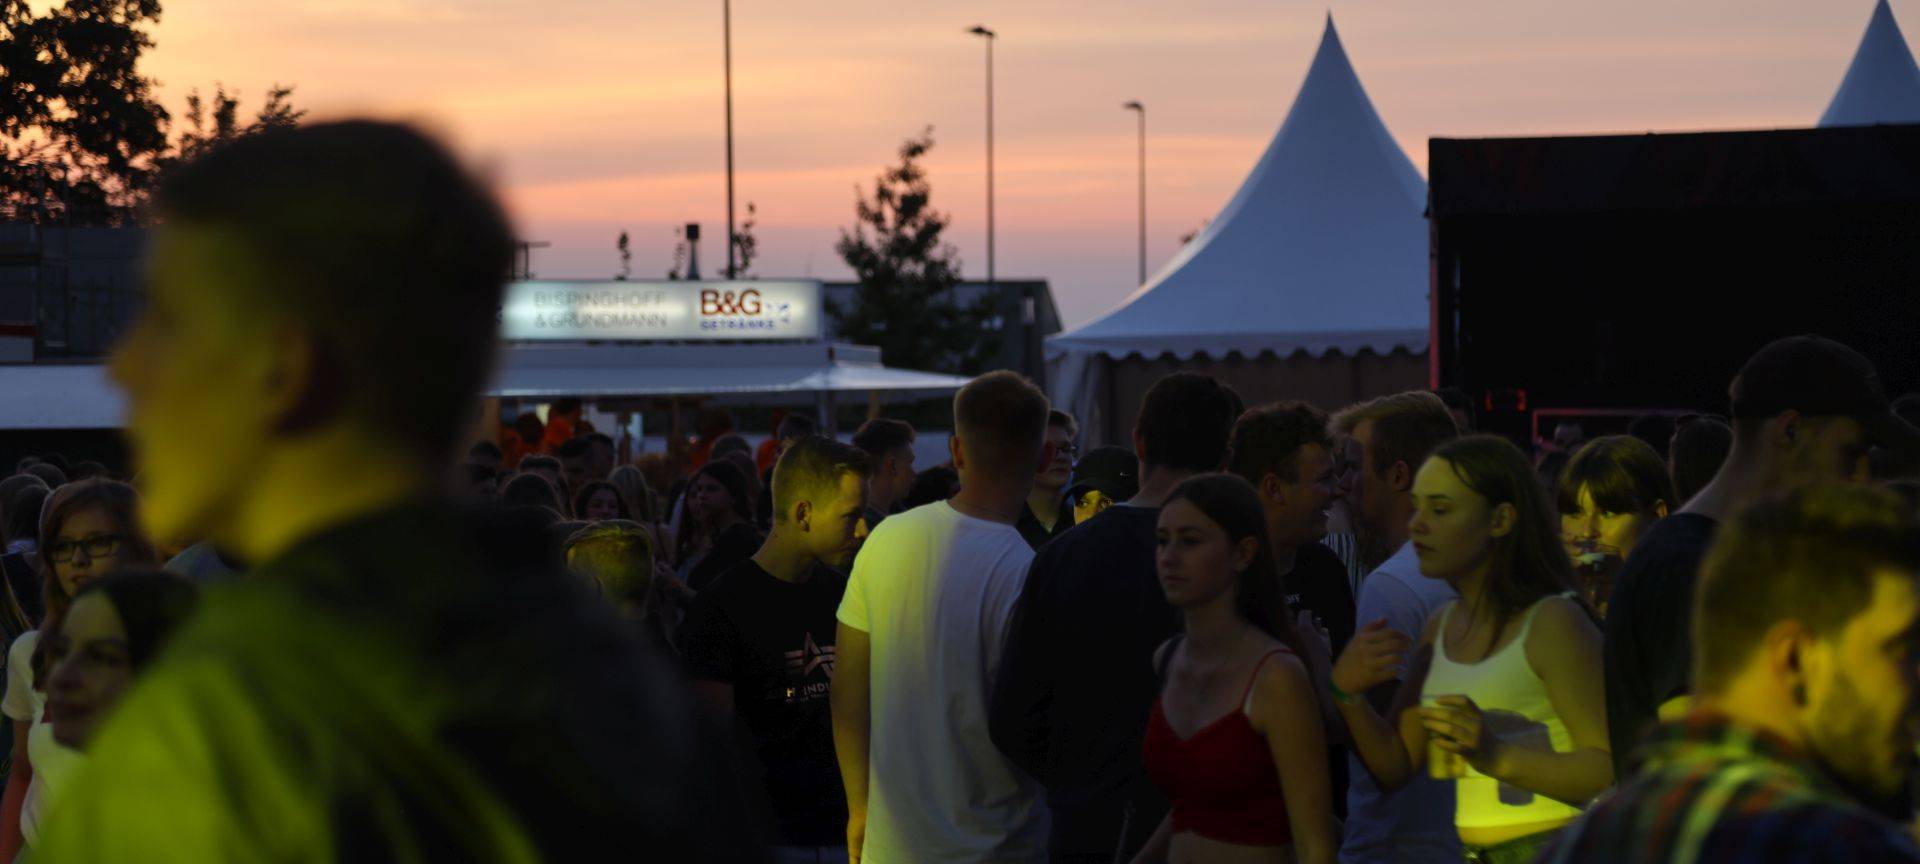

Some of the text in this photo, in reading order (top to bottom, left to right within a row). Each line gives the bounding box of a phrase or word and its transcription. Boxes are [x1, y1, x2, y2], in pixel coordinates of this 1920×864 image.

[534, 291, 666, 307] BISPINGHOFF
[701, 289, 762, 315] B&G
[534, 313, 668, 328] & GRUNDMANN
